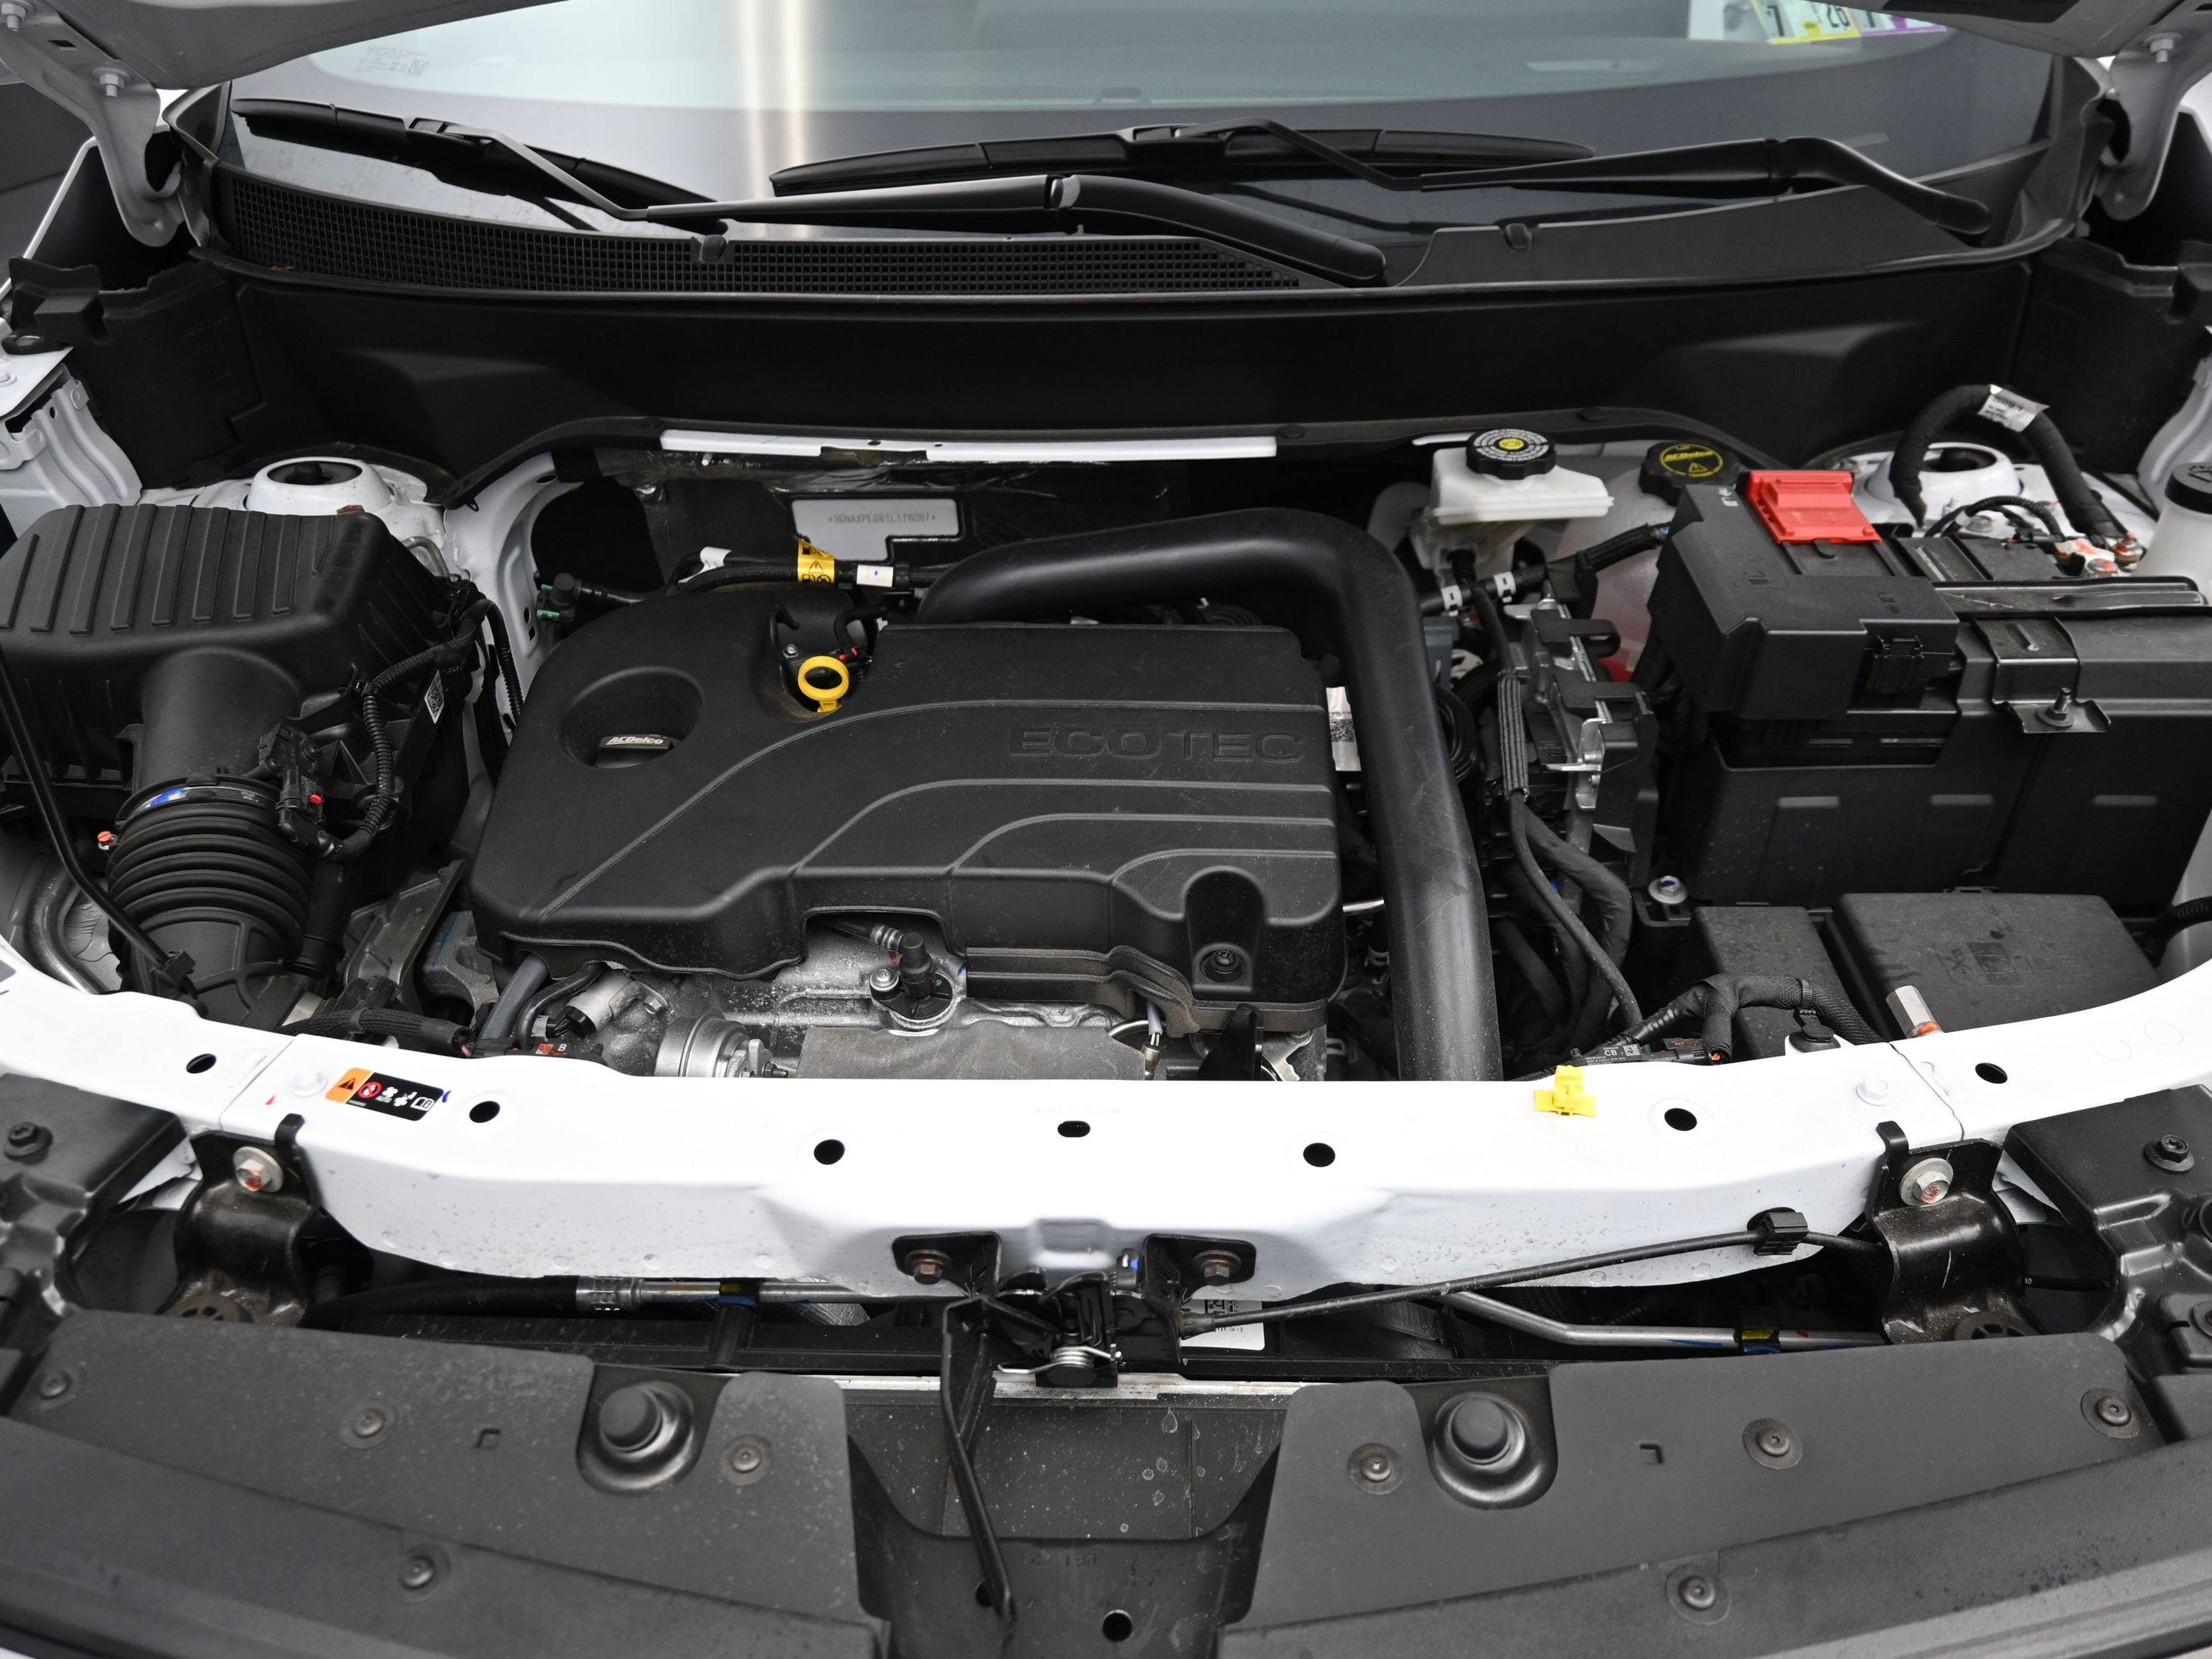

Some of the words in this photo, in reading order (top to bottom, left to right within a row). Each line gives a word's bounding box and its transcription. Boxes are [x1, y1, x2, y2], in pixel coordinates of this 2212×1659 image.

[606, 736, 664, 745] ACDelco
[1009, 726, 1305, 763] ECOTEC
[557, 1043, 567, 1051] B
